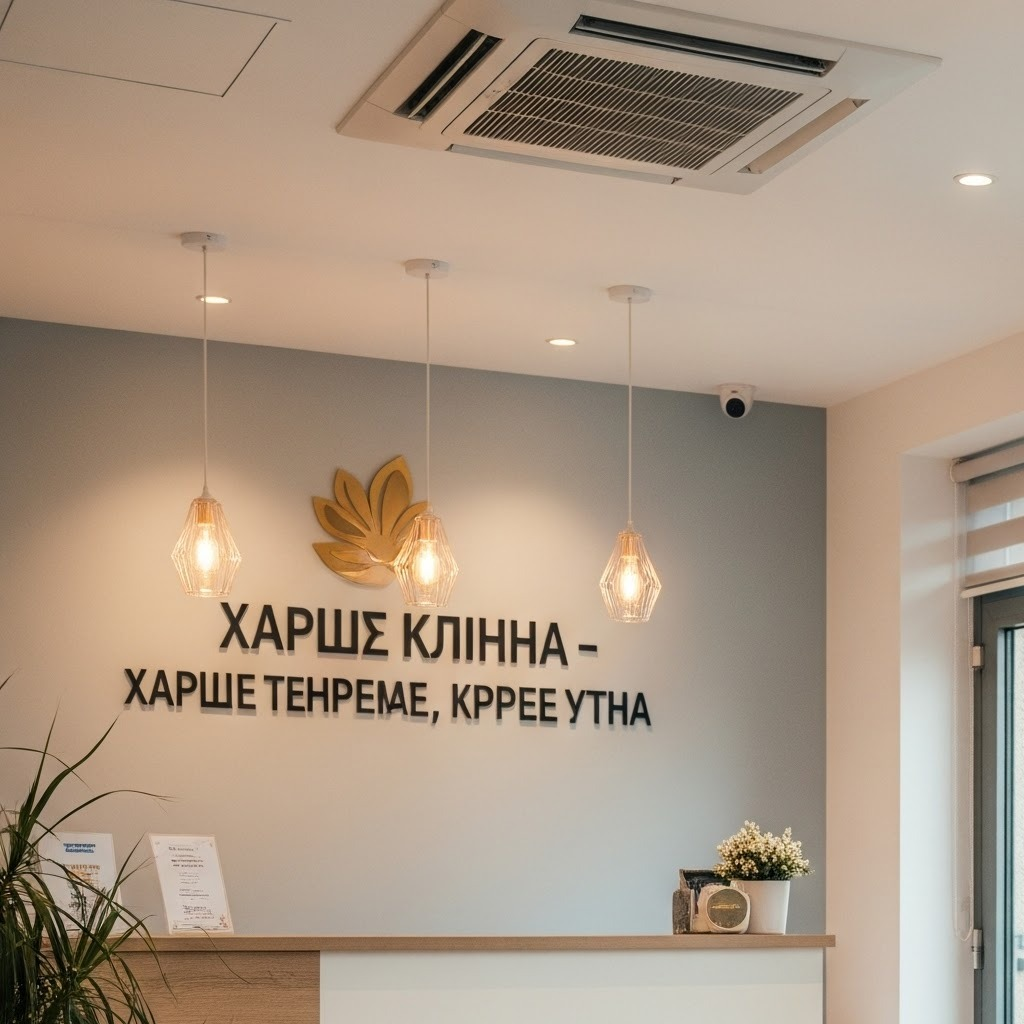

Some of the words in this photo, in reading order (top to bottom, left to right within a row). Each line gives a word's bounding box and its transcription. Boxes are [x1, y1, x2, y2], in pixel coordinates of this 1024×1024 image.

[124, 668, 257, 710] ХАРШЕ
[452, 683, 558, 722] КРРЕЕ
[565, 688, 652, 727] УТНА
